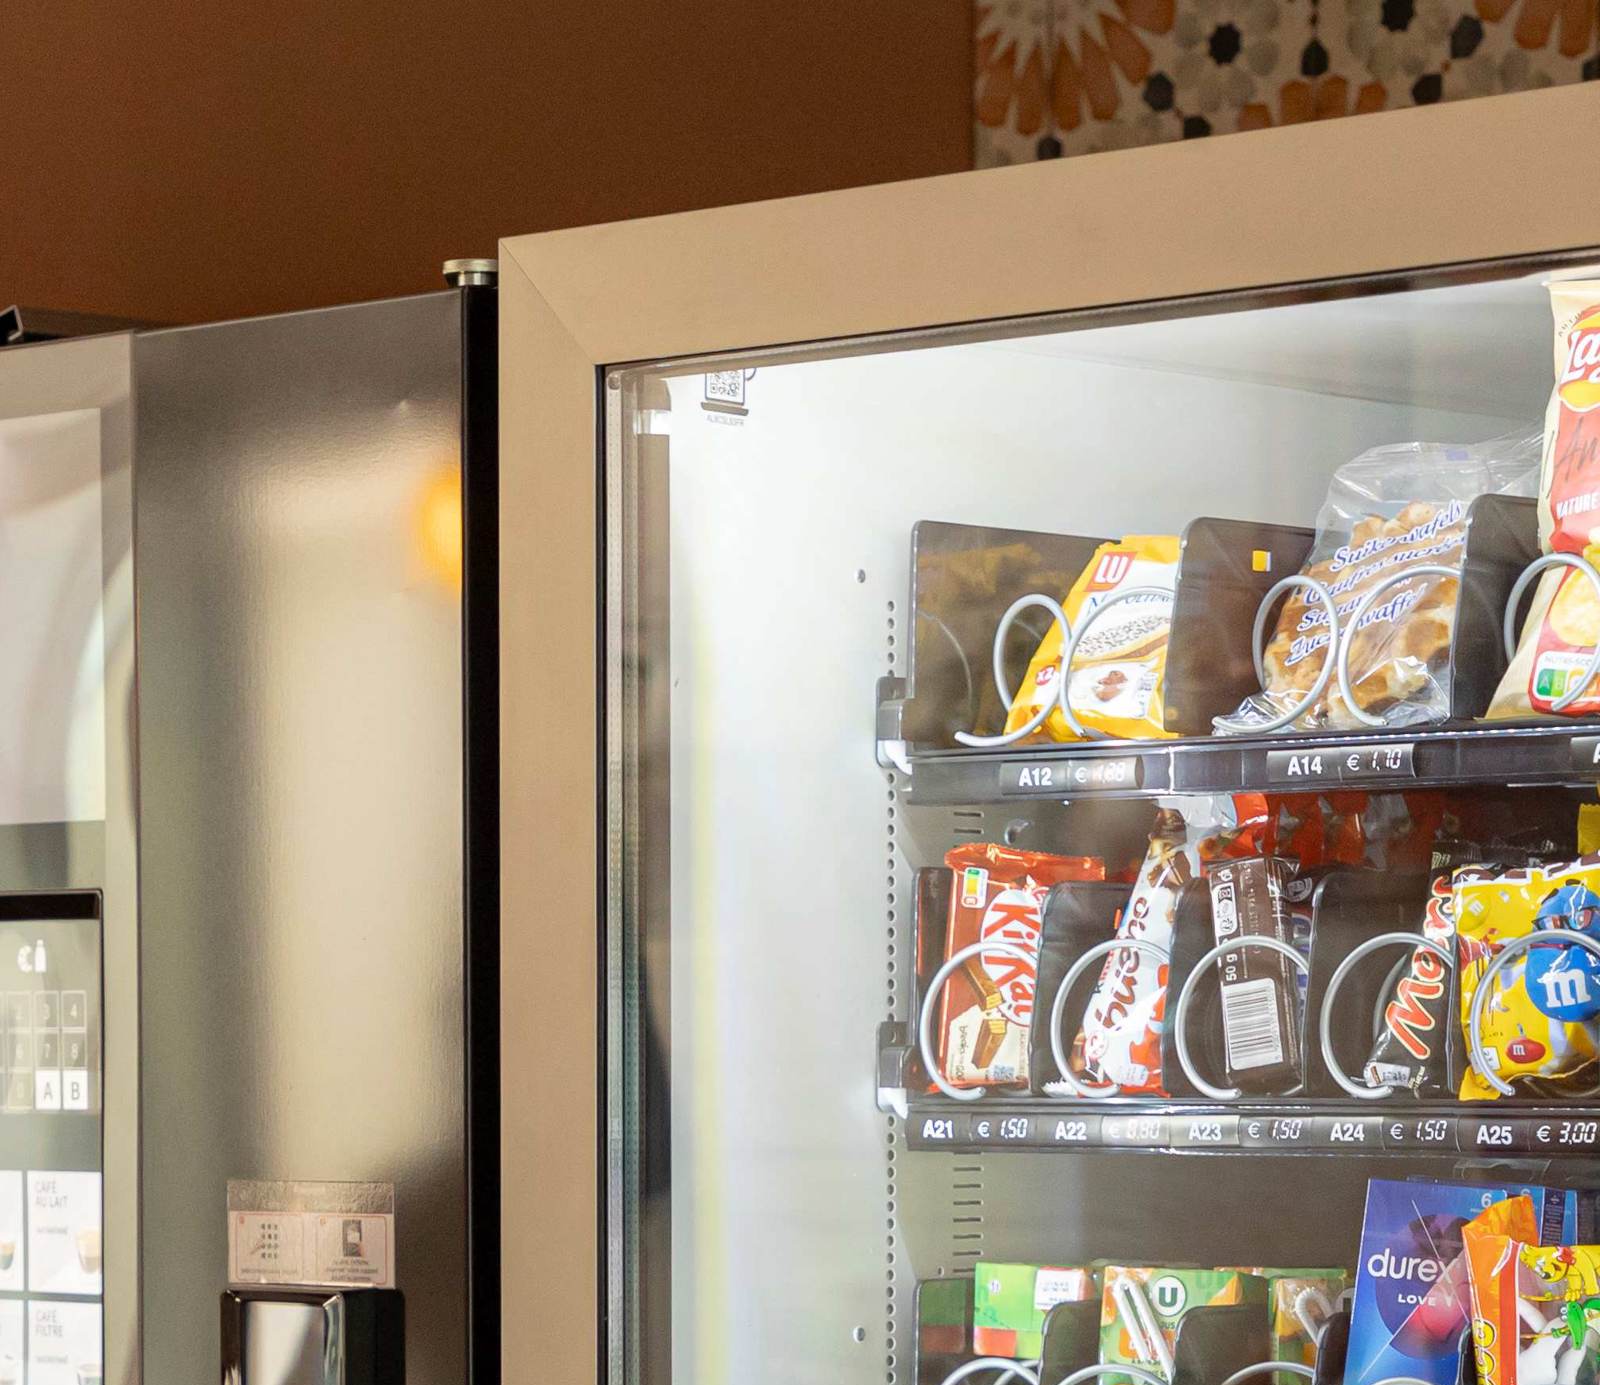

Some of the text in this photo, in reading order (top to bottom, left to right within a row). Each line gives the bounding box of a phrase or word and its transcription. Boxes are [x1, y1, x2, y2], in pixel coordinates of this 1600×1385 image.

[1094, 555, 1129, 583] LU
[1288, 756, 1323, 776] A14
[1346, 754, 1360, 771] €
[1019, 767, 1053, 786] A12
[1075, 767, 1088, 783] €
[1226, 953, 1238, 981] 50 g
[1539, 966, 1592, 1009] m
[69, 1003, 78, 1018] 4
[71, 1043, 79, 1059] 8
[43, 1081, 54, 1100] A
[71, 1081, 81, 1100] B
[922, 1118, 1029, 1139] A21 € 1,50
[1055, 1121, 1088, 1140] A22
[1109, 1121, 1121, 1139] €
[1188, 1119, 1303, 1141] A23 € 1,50
[1330, 1120, 1448, 1142] A24 € 1,50
[1476, 1122, 1598, 1145] A25 € 3,00
[1480, 1192, 1493, 1208] 6
[1367, 1248, 1452, 1284] durex
[1158, 1286, 1178, 1308] U
[1398, 1294, 1437, 1306] LOVE
